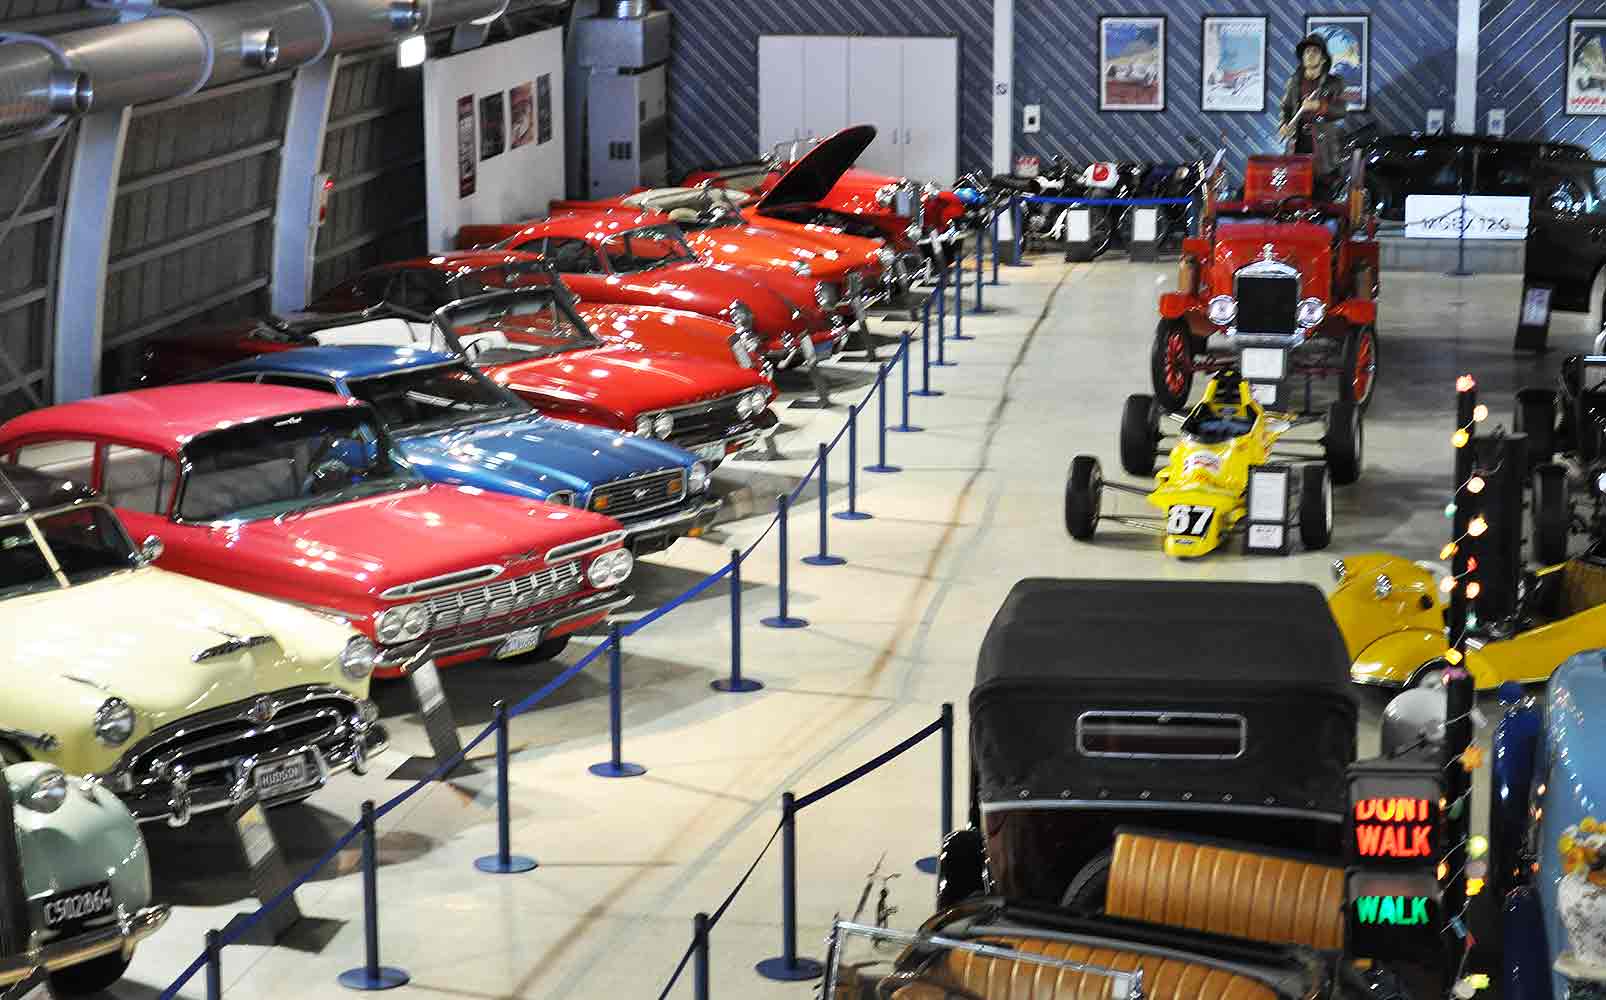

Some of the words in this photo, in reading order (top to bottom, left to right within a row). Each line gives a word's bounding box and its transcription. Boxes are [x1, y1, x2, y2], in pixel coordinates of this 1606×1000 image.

[1355, 798, 1429, 822] DONT
[1355, 824, 1432, 857] WALK
[1356, 895, 1430, 925] WALK
